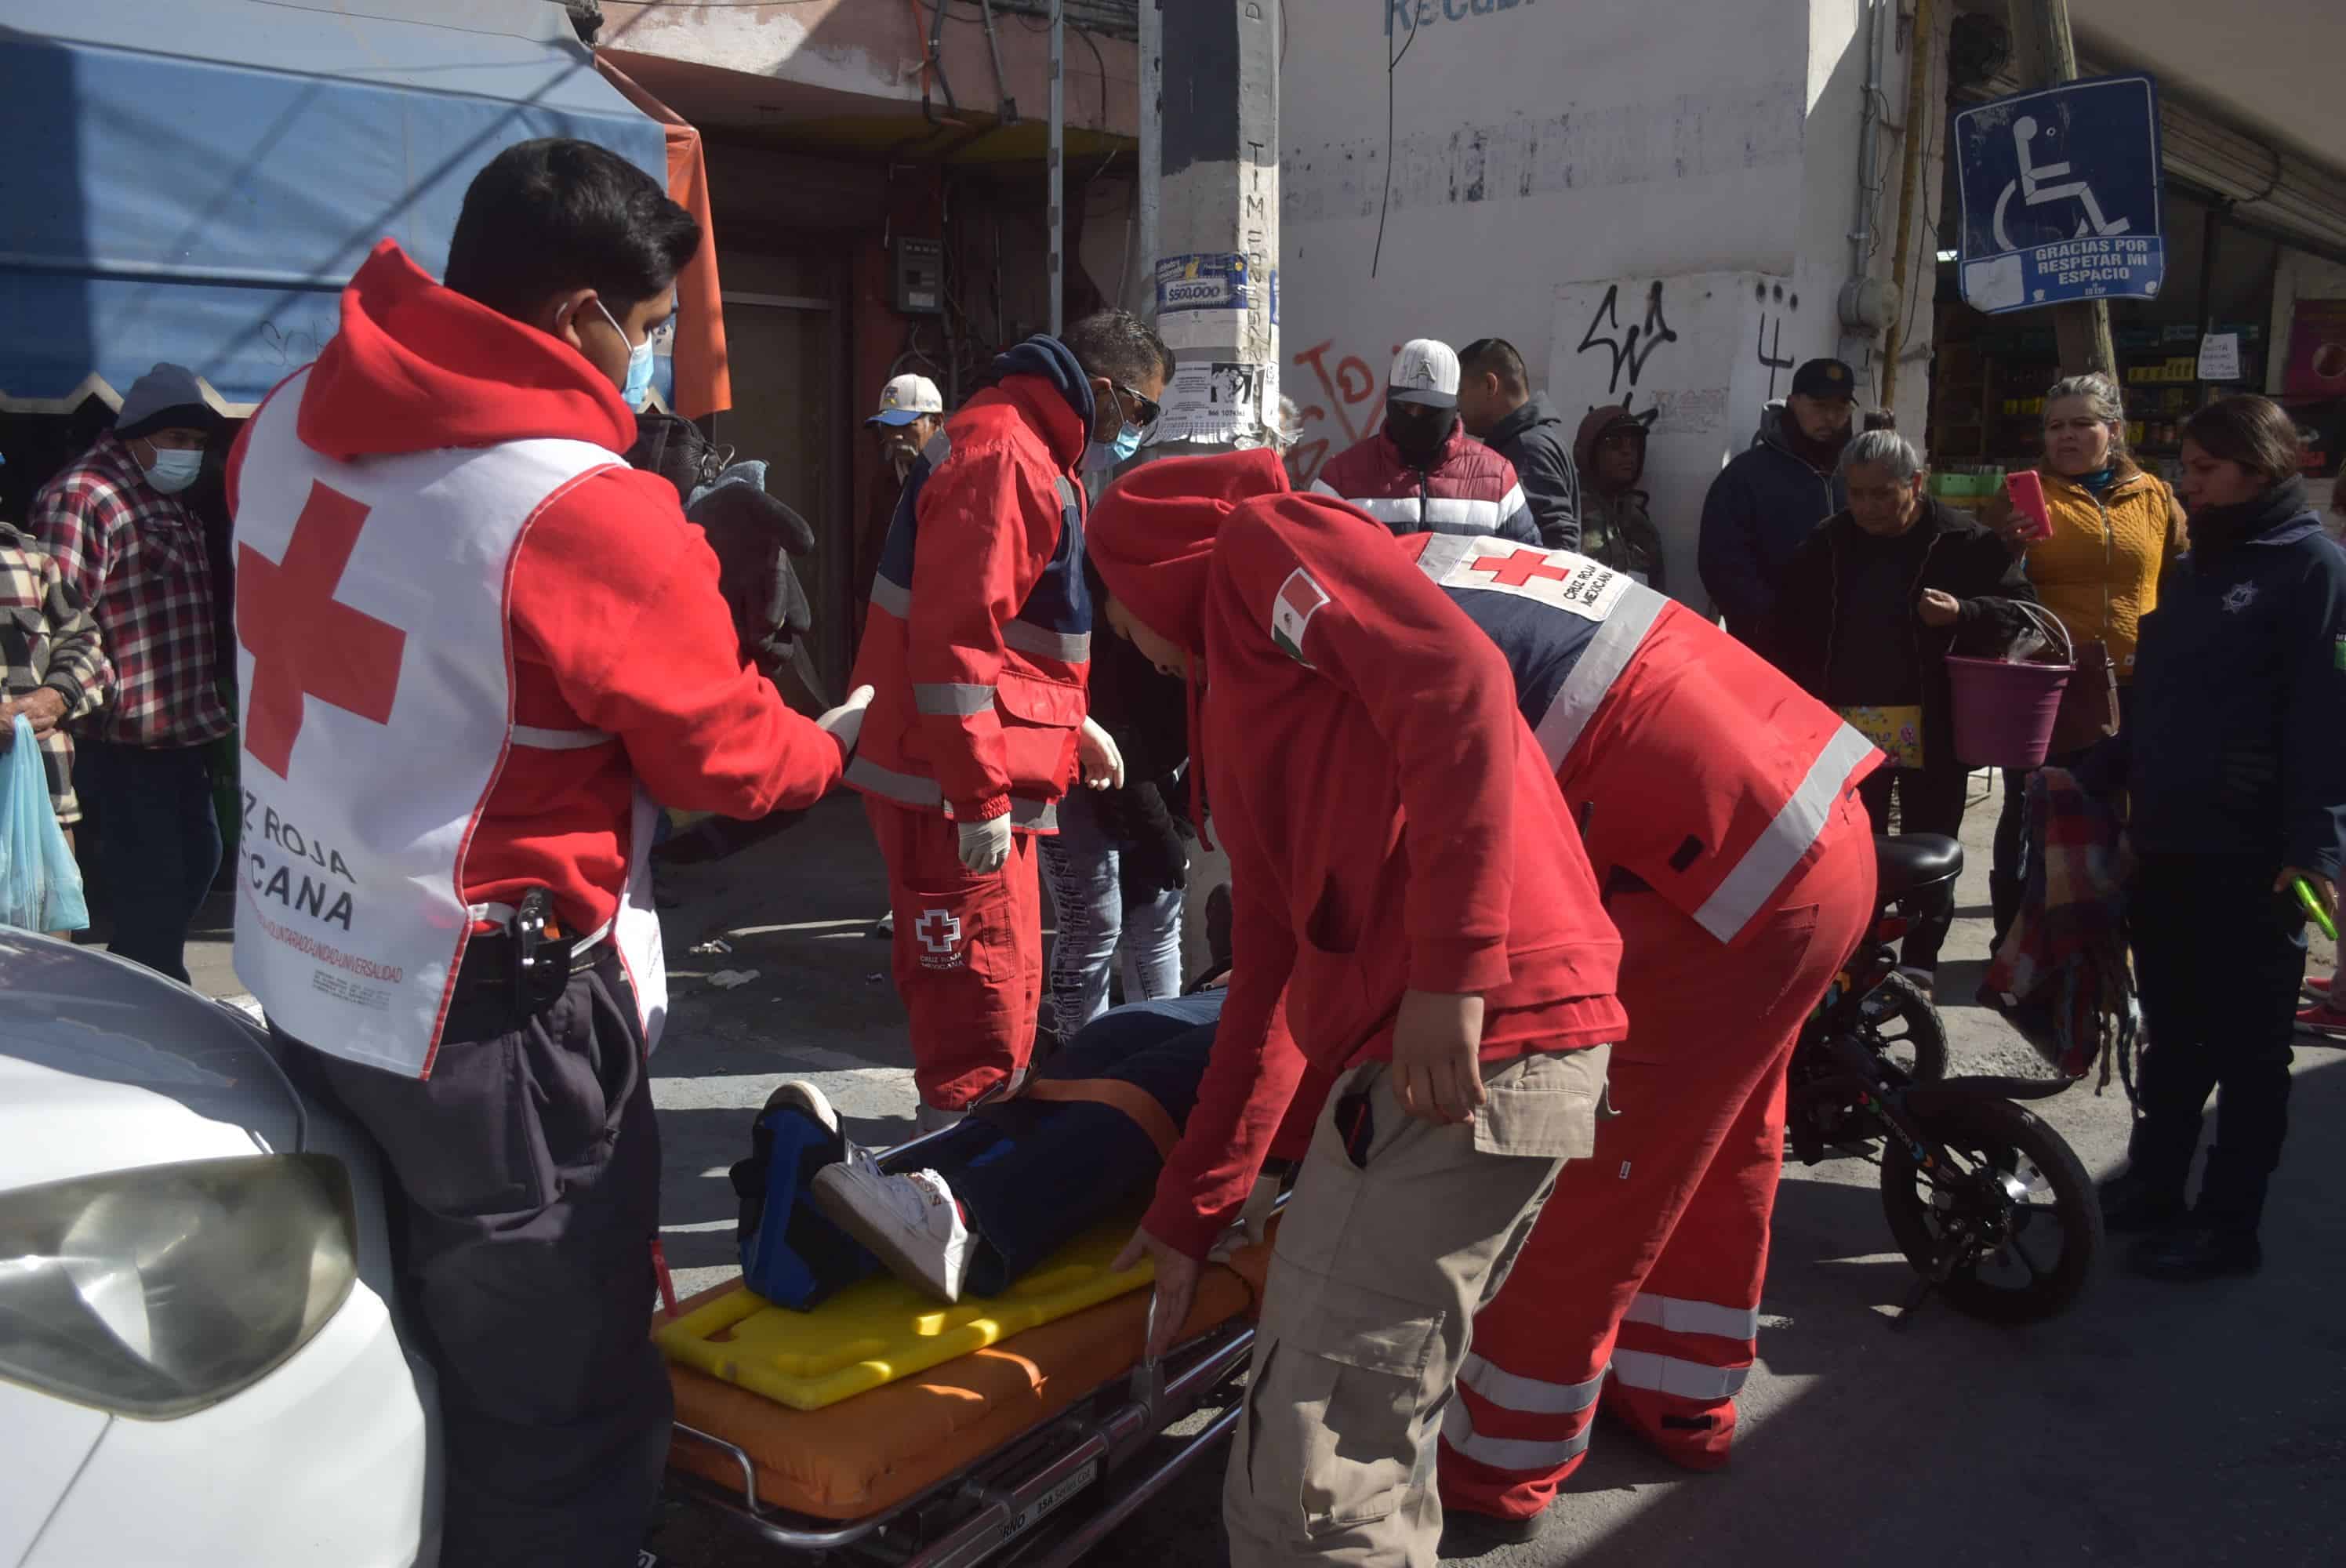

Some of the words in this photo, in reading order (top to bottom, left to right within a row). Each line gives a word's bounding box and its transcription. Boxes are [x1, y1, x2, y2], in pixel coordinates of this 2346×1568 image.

[2036, 240, 2110, 261] GRACIAS
[2115, 239, 2148, 252] POR
[2039, 253, 2121, 275] RESPETAR
[2127, 253, 2148, 266] MI
[2058, 267, 2130, 285] ESPACIO
[1411, 358, 1436, 383] A
[1563, 579, 1585, 600] CRUZ
[263, 804, 358, 884] ROJA
[242, 836, 353, 931] CANA
